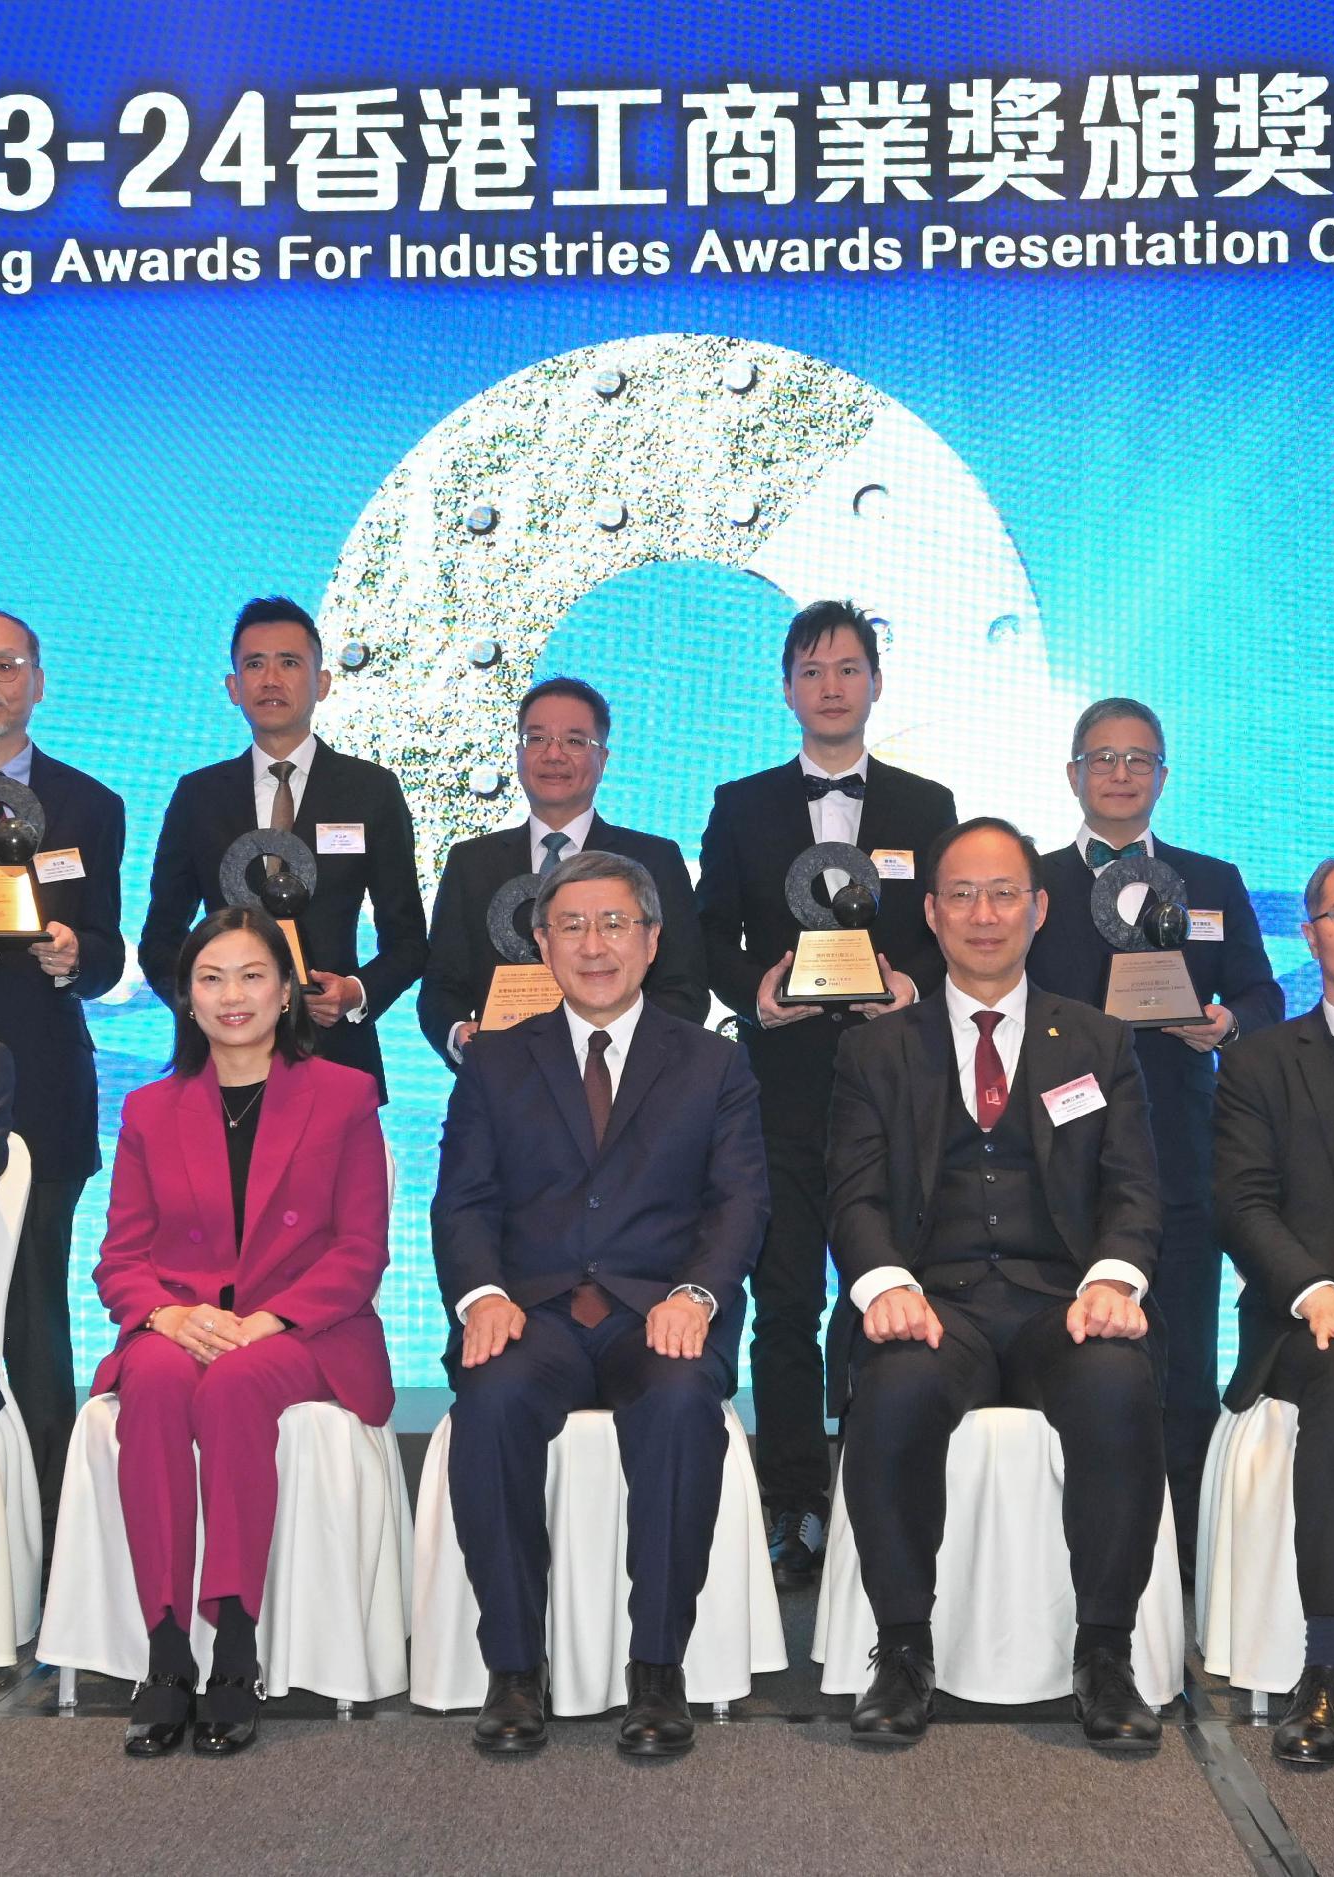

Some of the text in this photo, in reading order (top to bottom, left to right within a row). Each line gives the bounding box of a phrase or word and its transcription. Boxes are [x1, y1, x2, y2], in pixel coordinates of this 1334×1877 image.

[51, 237, 261, 283] Awards
[279, 236, 373, 280] For
[389, 231, 671, 279] Industries
[690, 227, 903, 274] Awards
[922, 220, 1290, 270] Presentation
